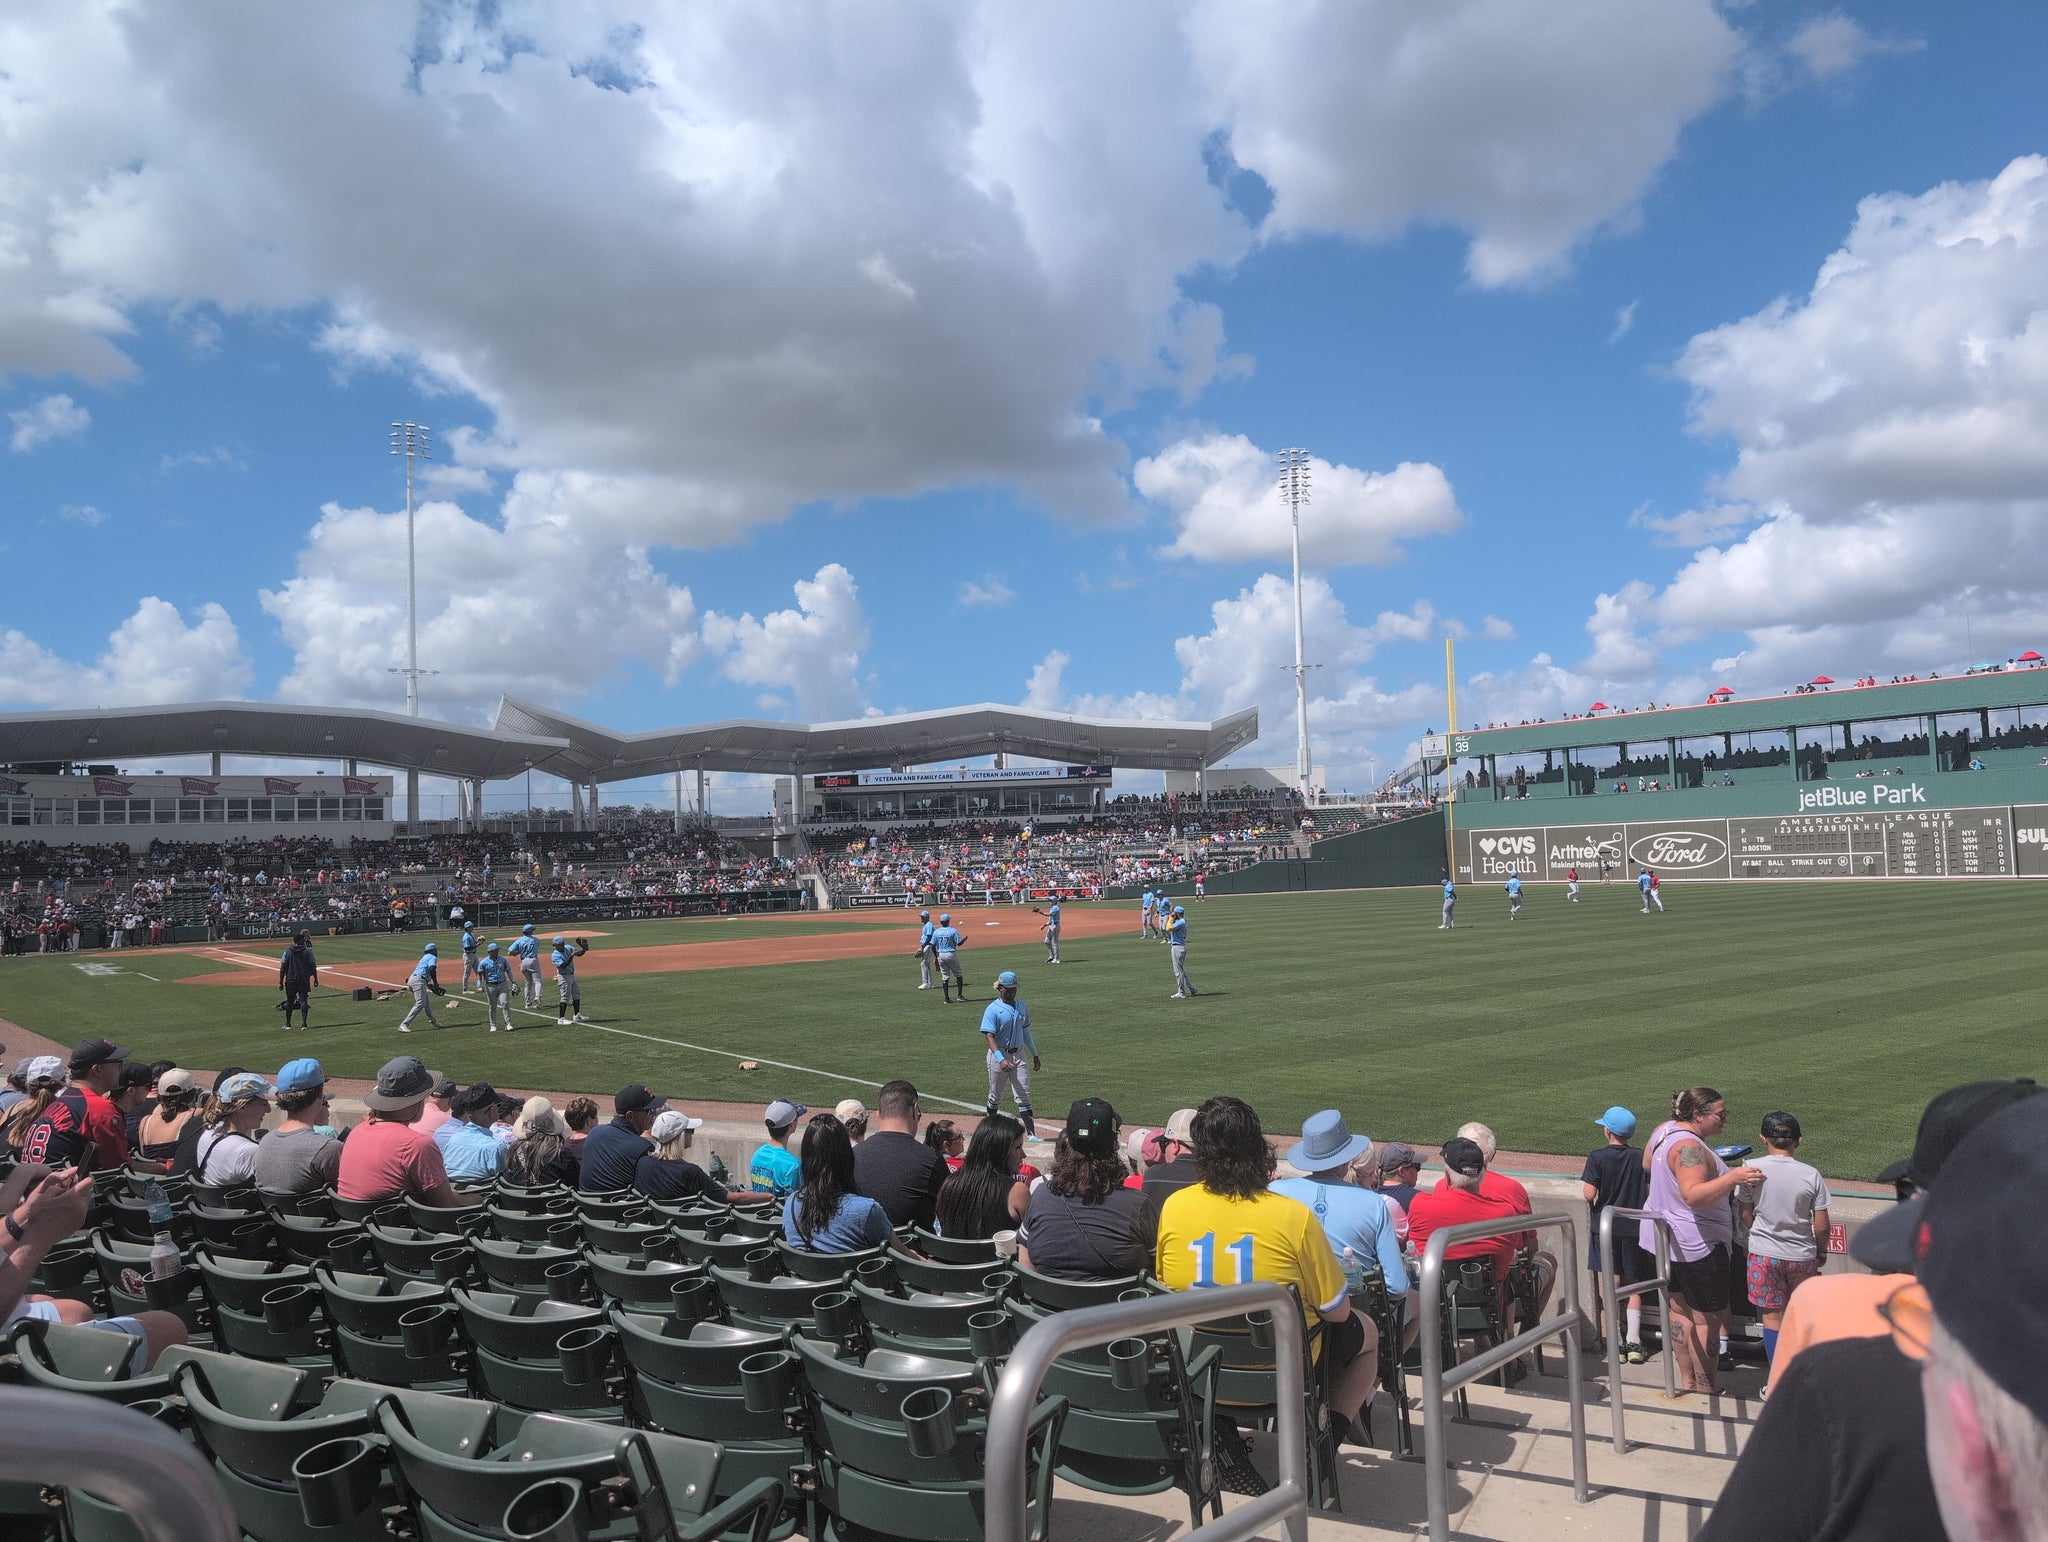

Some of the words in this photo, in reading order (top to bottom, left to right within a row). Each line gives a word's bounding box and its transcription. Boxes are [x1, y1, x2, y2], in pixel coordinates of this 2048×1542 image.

[1456, 742, 1468, 752] 39
[1798, 787, 1866, 812] jetBlue
[1874, 783, 1926, 805] Park
[1780, 816, 1864, 826] AMERICAN
[1885, 813, 1952, 821] LEAGUE
[1497, 836, 1536, 855] CVS
[1551, 845, 1602, 860] Arthrex
[1648, 837, 1706, 863] Ford
[1482, 856, 1537, 874] Health
[1576, 861, 1599, 869] People
[21, 1124, 51, 1164] 18
[1187, 1232, 1254, 1291] 11
